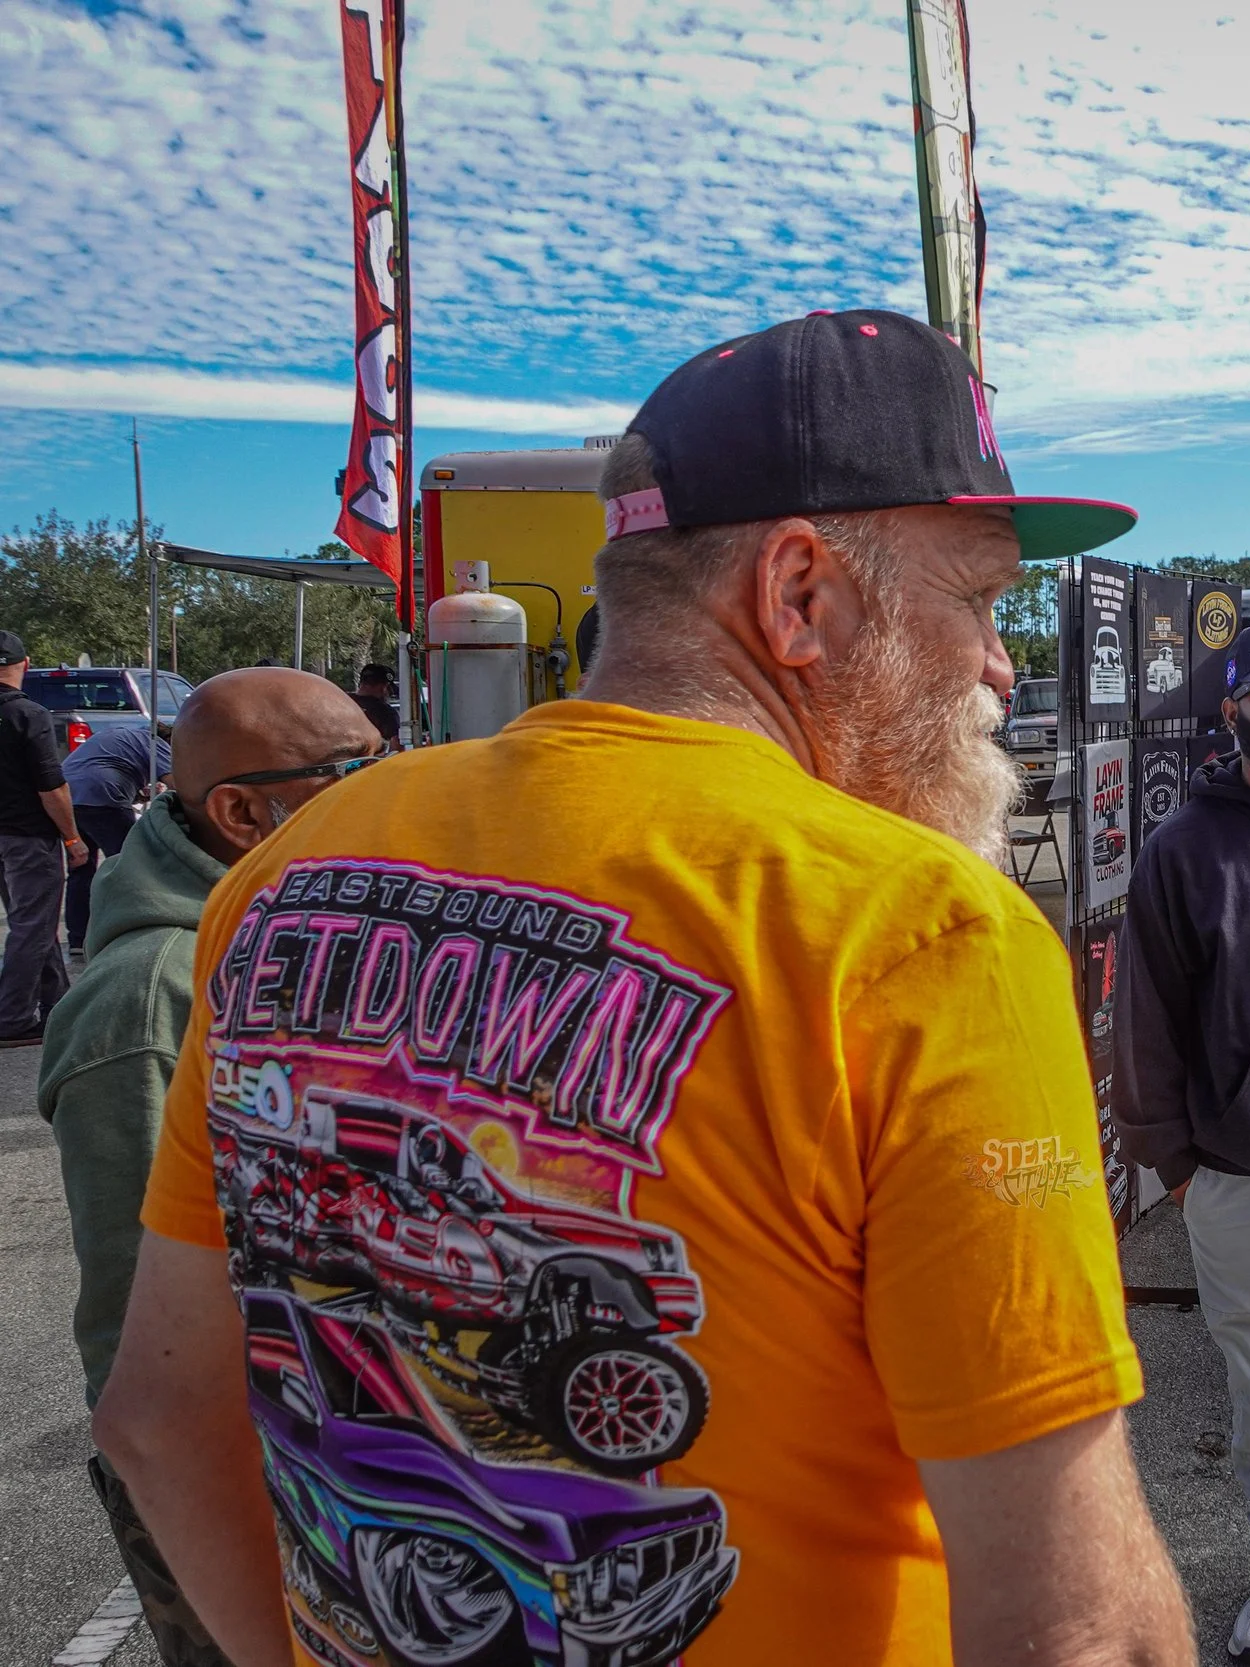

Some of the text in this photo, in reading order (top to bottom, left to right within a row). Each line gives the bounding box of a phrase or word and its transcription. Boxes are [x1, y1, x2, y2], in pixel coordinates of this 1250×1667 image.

[1096, 758, 1122, 791] LAYIN
[1093, 785, 1124, 821] FRAME
[1096, 862, 1124, 882] CLOTHING
[280, 871, 602, 954] EASTBOUND
[208, 901, 701, 1146] GETDOWN
[981, 1135, 1074, 1174] STEEL
